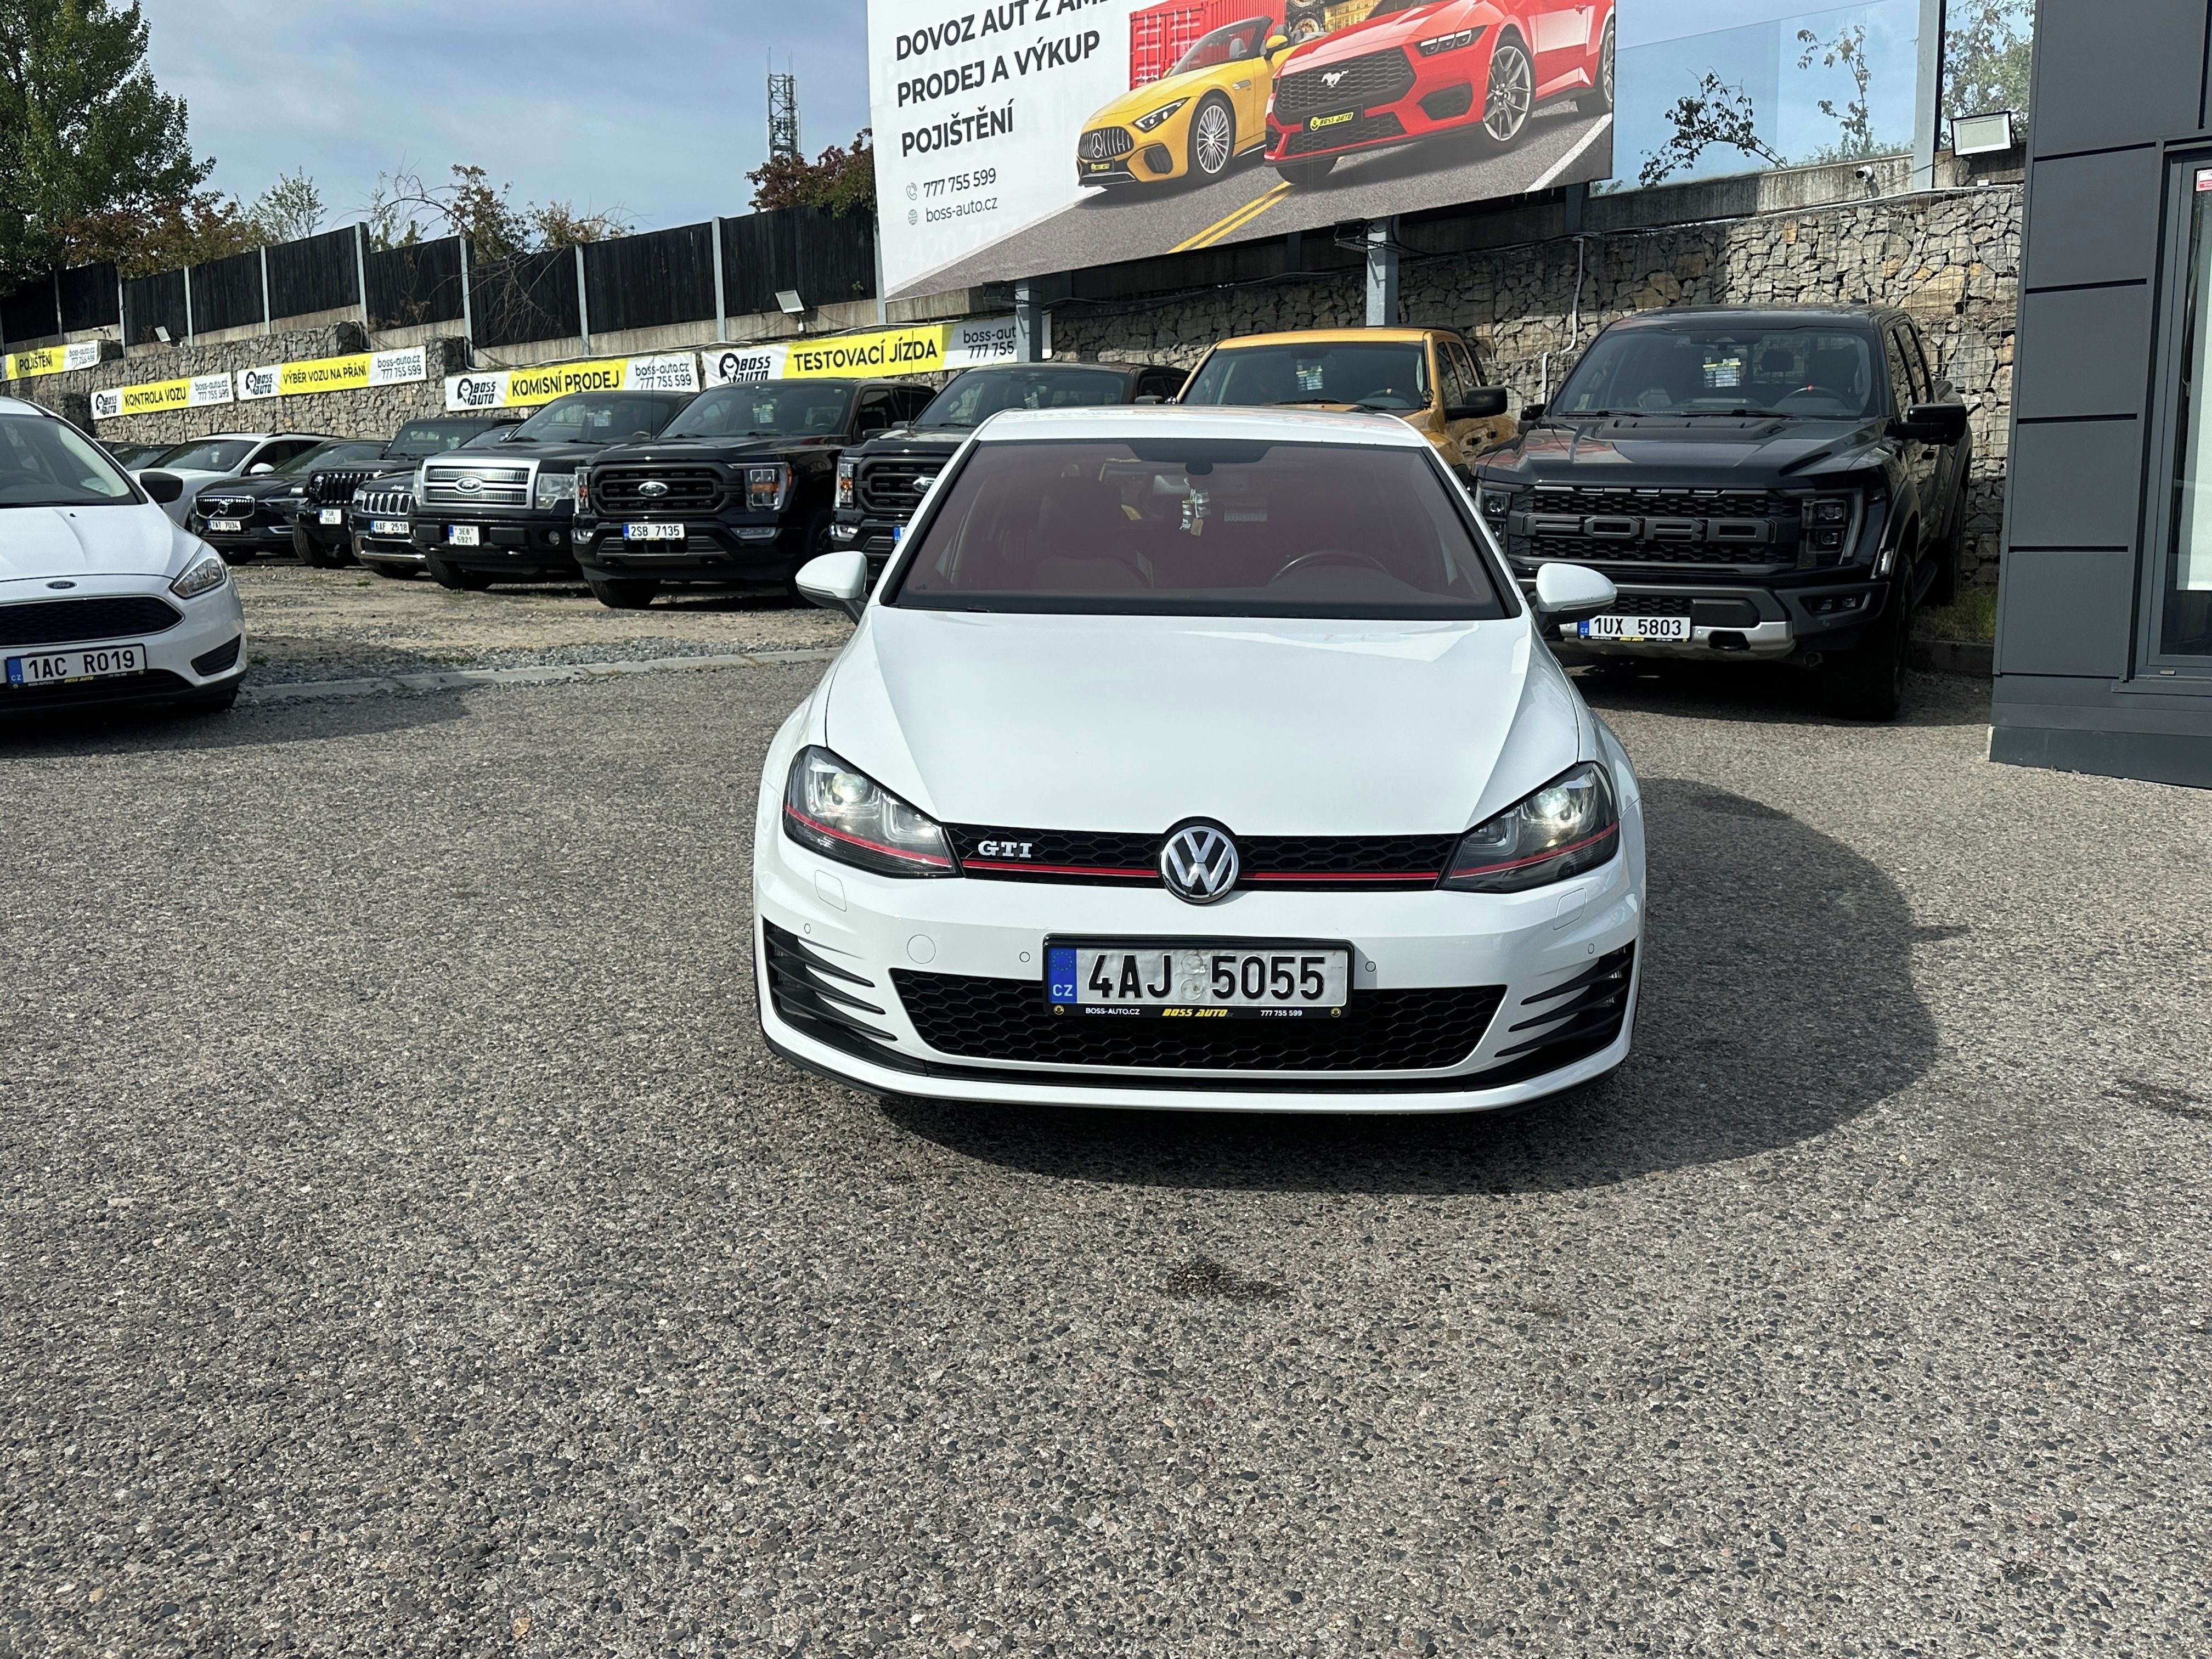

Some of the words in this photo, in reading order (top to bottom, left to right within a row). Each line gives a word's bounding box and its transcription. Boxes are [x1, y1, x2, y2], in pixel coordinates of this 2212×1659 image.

[896, 14, 975, 61] DOVOZ
[980, 0, 1030, 37] AUT
[1035, 0, 1051, 21] Z
[898, 60, 985, 108] PRODEJ
[991, 55, 1010, 83] A
[1013, 30, 1100, 76] VÝKUP
[901, 98, 1015, 157] POJIŠTĚNÍ
[923, 179, 945, 198] 777
[948, 173, 970, 193] 755
[973, 167, 996, 187] 599
[926, 198, 998, 223] boss-auto.cz
[963, 325, 1016, 345] boss-aut
[793, 338, 886, 372] TESTOVACÍ
[888, 336, 938, 363] JÍZDA
[967, 345, 989, 359] 777
[991, 340, 1015, 357] 755
[19, 351, 53, 371] POJIŠTĚNÍ
[377, 354, 421, 368] boss-auto.cz
[635, 362, 690, 377] boss-auto.cz
[739, 356, 771, 371] BOSS
[256, 373, 273, 385] BOSS
[283, 368, 307, 385] VÝBĚR
[308, 369, 329, 383] VOZU
[329, 368, 343, 380] NA
[342, 360, 367, 379] PŘÁNÍ
[381, 368, 394, 380] 777
[394, 366, 407, 378] 755
[407, 364, 422, 376] 599
[640, 376, 654, 390] 777
[656, 375, 673, 388] 755
[675, 373, 692, 387] 599
[194, 380, 229, 392] boss-auto.cz
[254, 384, 272, 395] AUTO
[473, 381, 496, 393] BOSS
[511, 370, 563, 397] KOMISNÍ
[565, 370, 620, 393] PRODEJ
[123, 390, 164, 407] KONTROLA
[164, 386, 187, 402] VOZU
[198, 392, 207, 401] 777
[207, 390, 218, 399] 755
[218, 388, 229, 398] 599
[469, 393, 495, 405] AUTO
[375, 522, 386, 531] 6AF
[391, 522, 408, 532] 2518
[630, 525, 649, 537] 2SB
[654, 525, 680, 537] 7135
[1524, 512, 1776, 544] FORD
[456, 535, 473, 544] 5921
[1594, 617, 1624, 635] 1UX
[1637, 618, 1682, 636] 5803
[29, 657, 67, 679] 1AC
[83, 650, 135, 674] R019
[978, 840, 1032, 859] GTI
[1052, 985, 1074, 997] CZ
[1088, 953, 1173, 1000] 4AJ
[1211, 955, 1326, 1001] 5055
[1085, 1007, 1141, 1015] BOSS-AUTO.CZ
[1161, 1008, 1194, 1017] BOSS
[1194, 1008, 1229, 1018] AUTO
